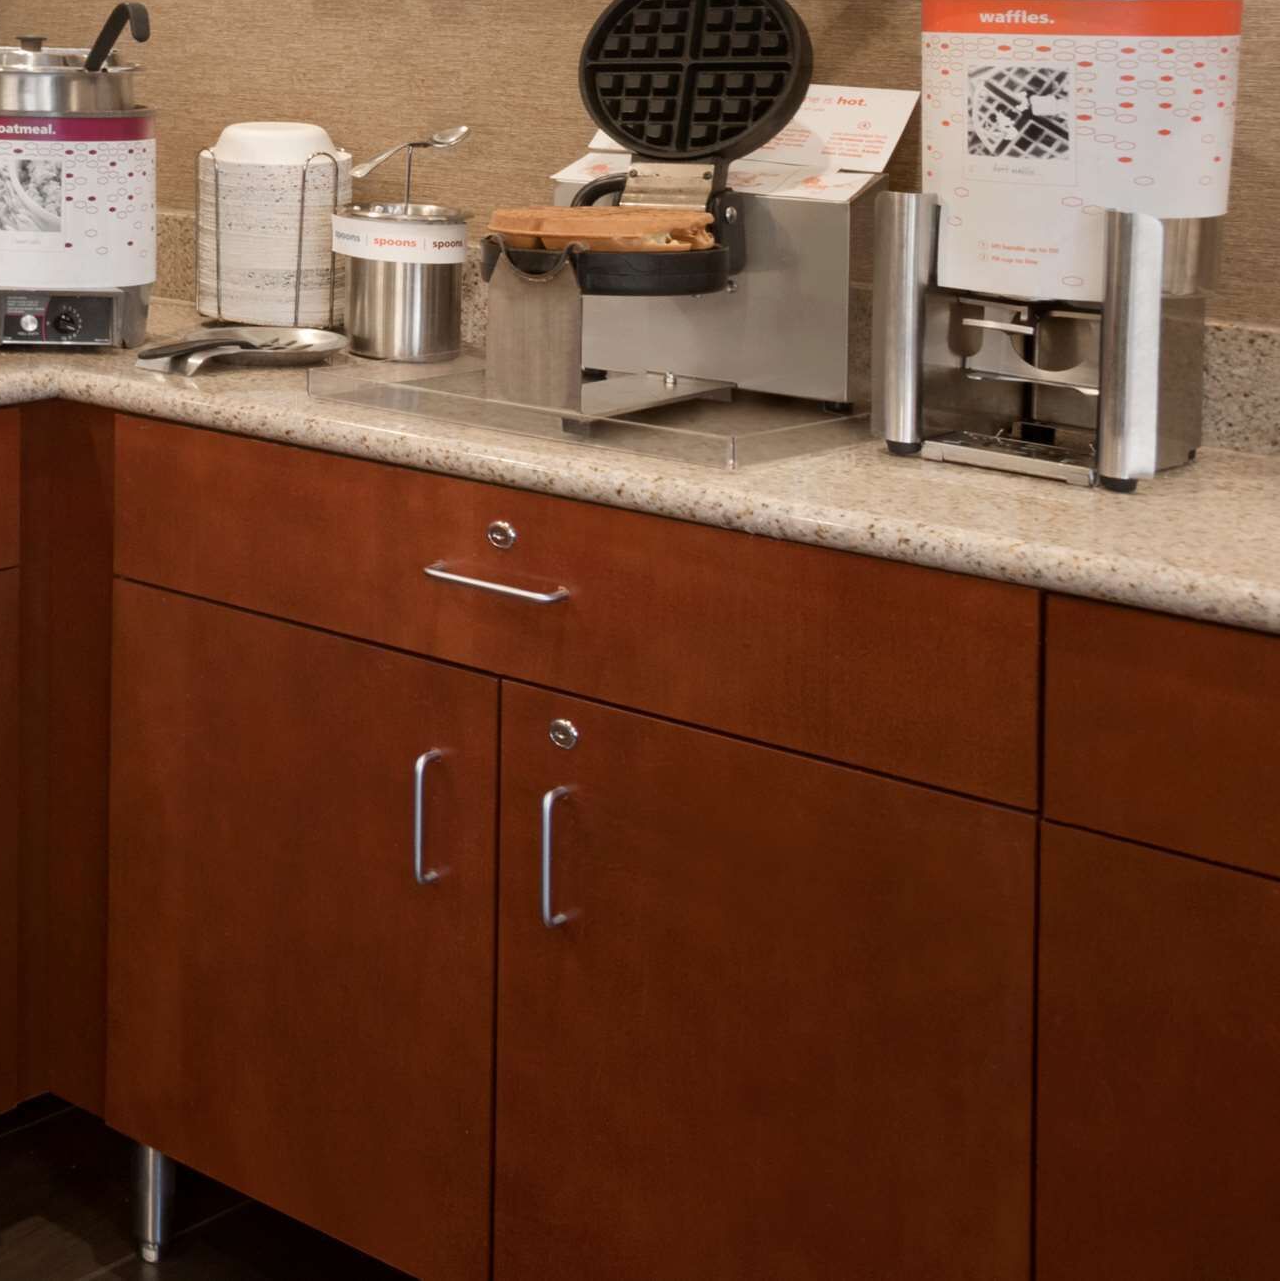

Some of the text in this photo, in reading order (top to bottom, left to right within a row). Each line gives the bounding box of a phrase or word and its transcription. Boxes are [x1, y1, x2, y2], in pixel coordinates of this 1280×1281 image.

[978, 8, 1055, 25] waffles.
[836, 95, 868, 107] hot.
[373, 237, 418, 248] spoons
